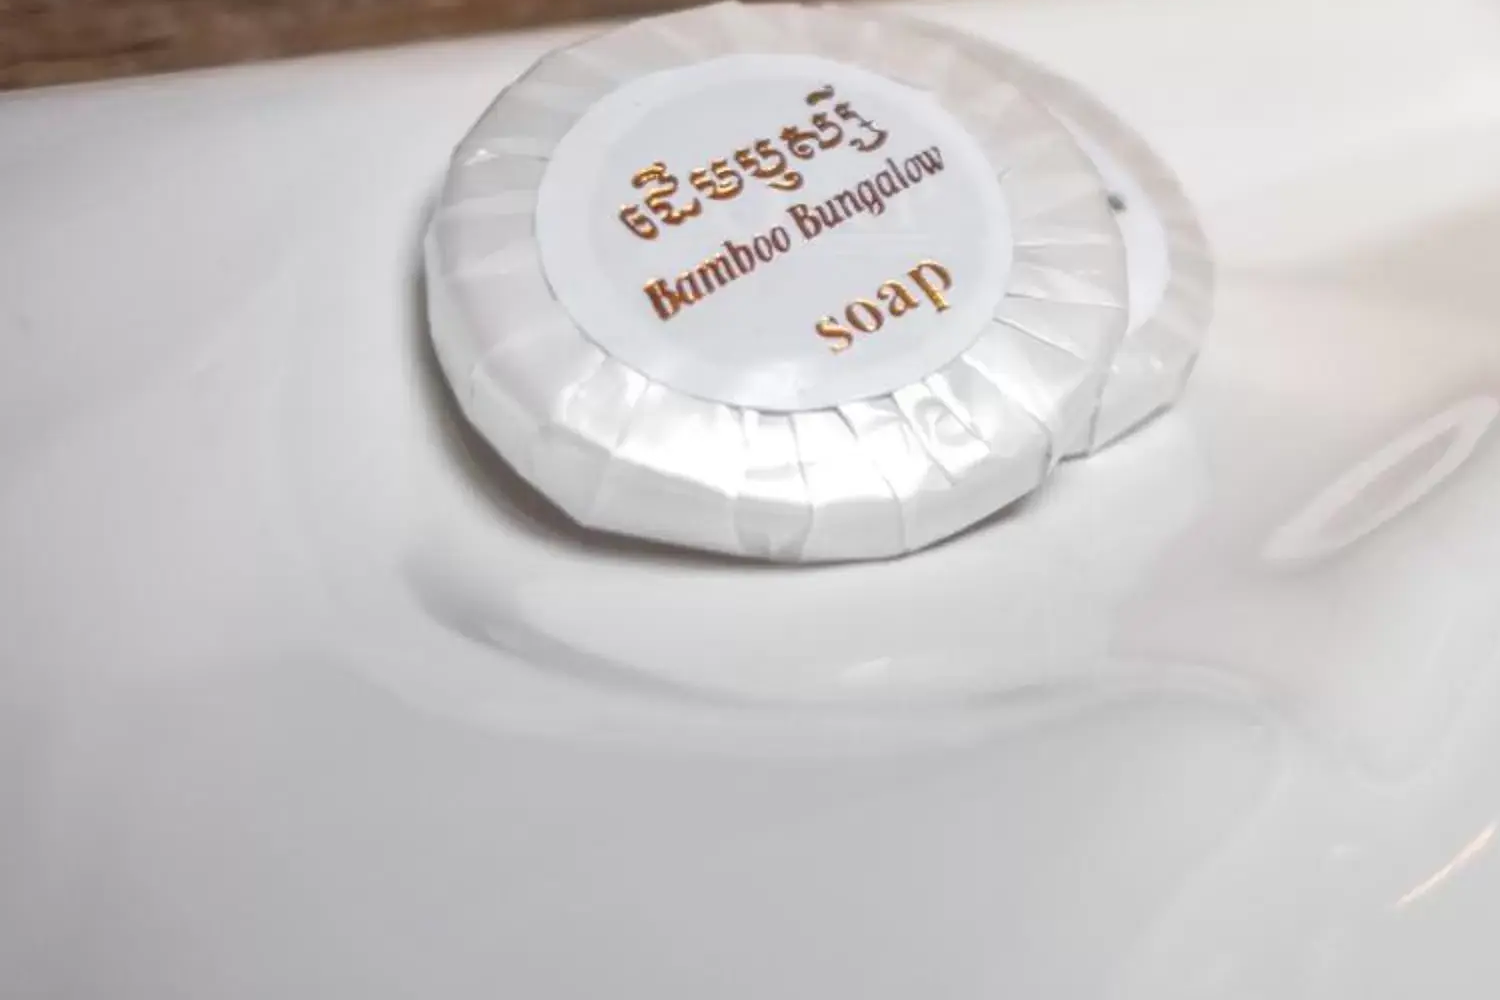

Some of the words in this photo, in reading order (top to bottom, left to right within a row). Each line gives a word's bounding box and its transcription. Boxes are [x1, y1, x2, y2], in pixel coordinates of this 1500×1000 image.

[644, 226, 791, 321] Bamboo
[786, 146, 945, 241] Bungalow
[814, 258, 952, 352] soap
